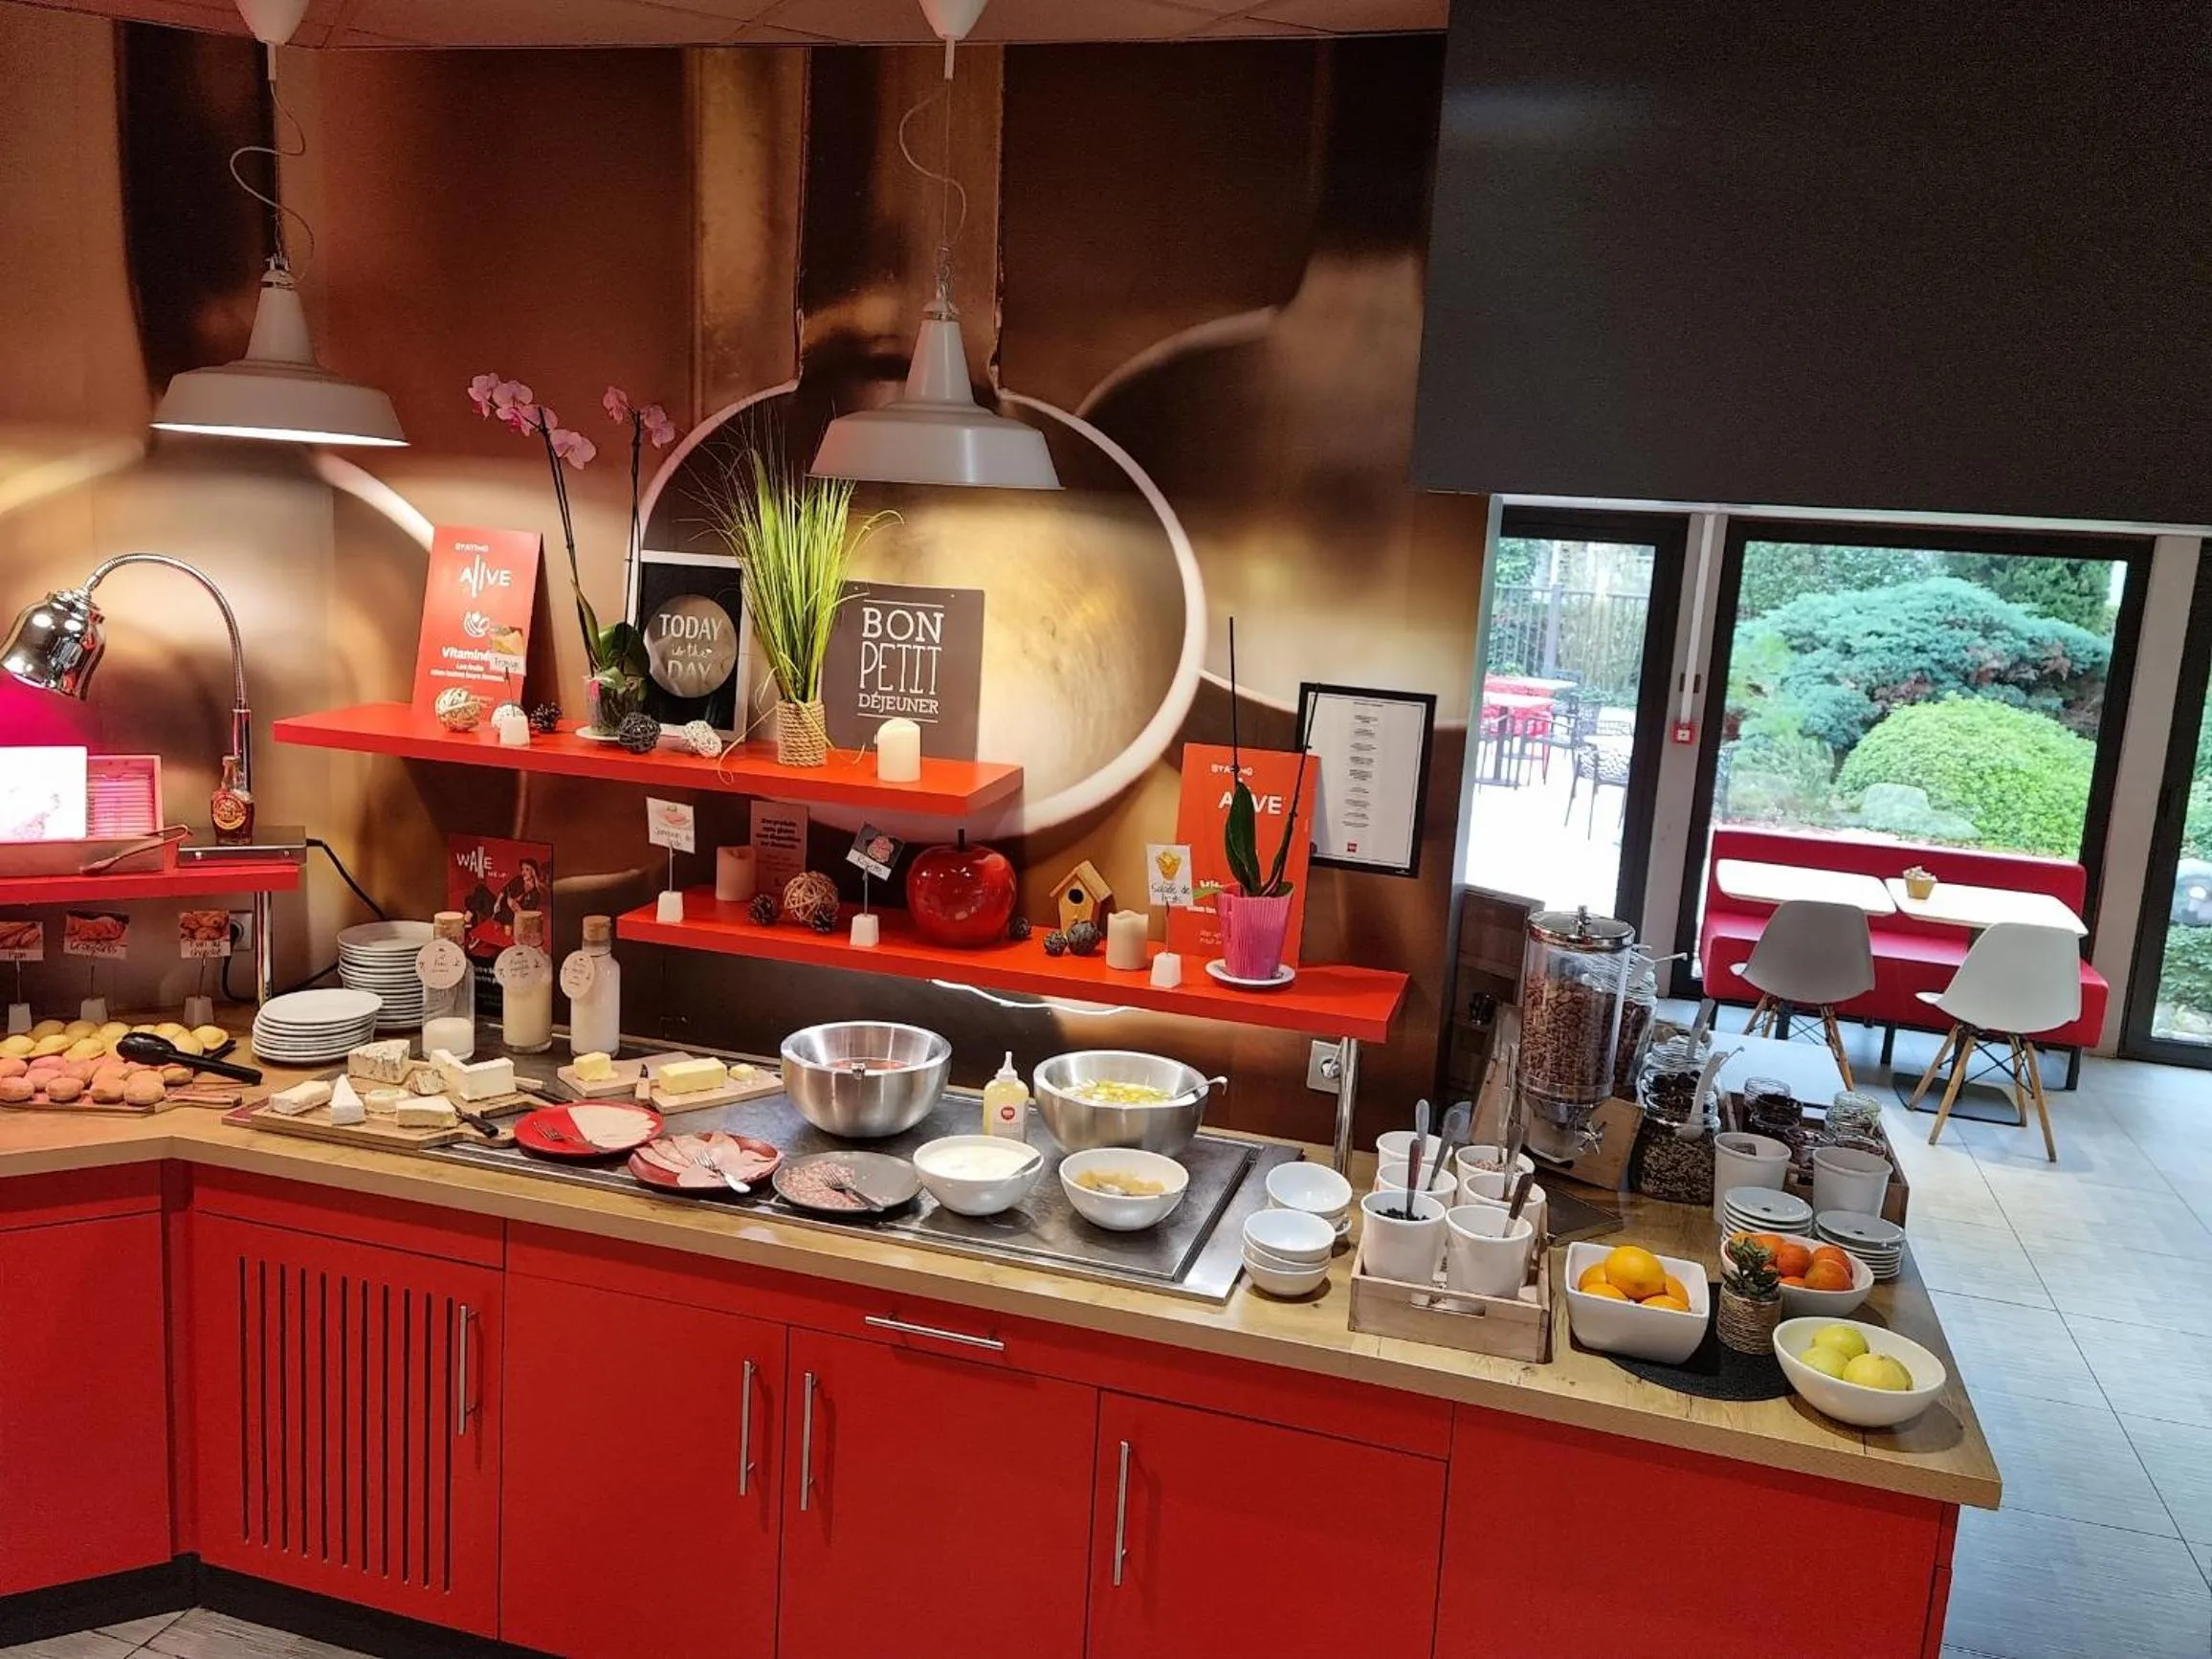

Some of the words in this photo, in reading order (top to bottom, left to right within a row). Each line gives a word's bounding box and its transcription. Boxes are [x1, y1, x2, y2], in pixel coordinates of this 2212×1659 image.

[658, 613, 723, 642] TODAY
[862, 607, 944, 643] BON
[666, 659, 712, 681] DAY
[859, 641, 942, 696] PETIT
[857, 691, 940, 715] DÉJEUNER
